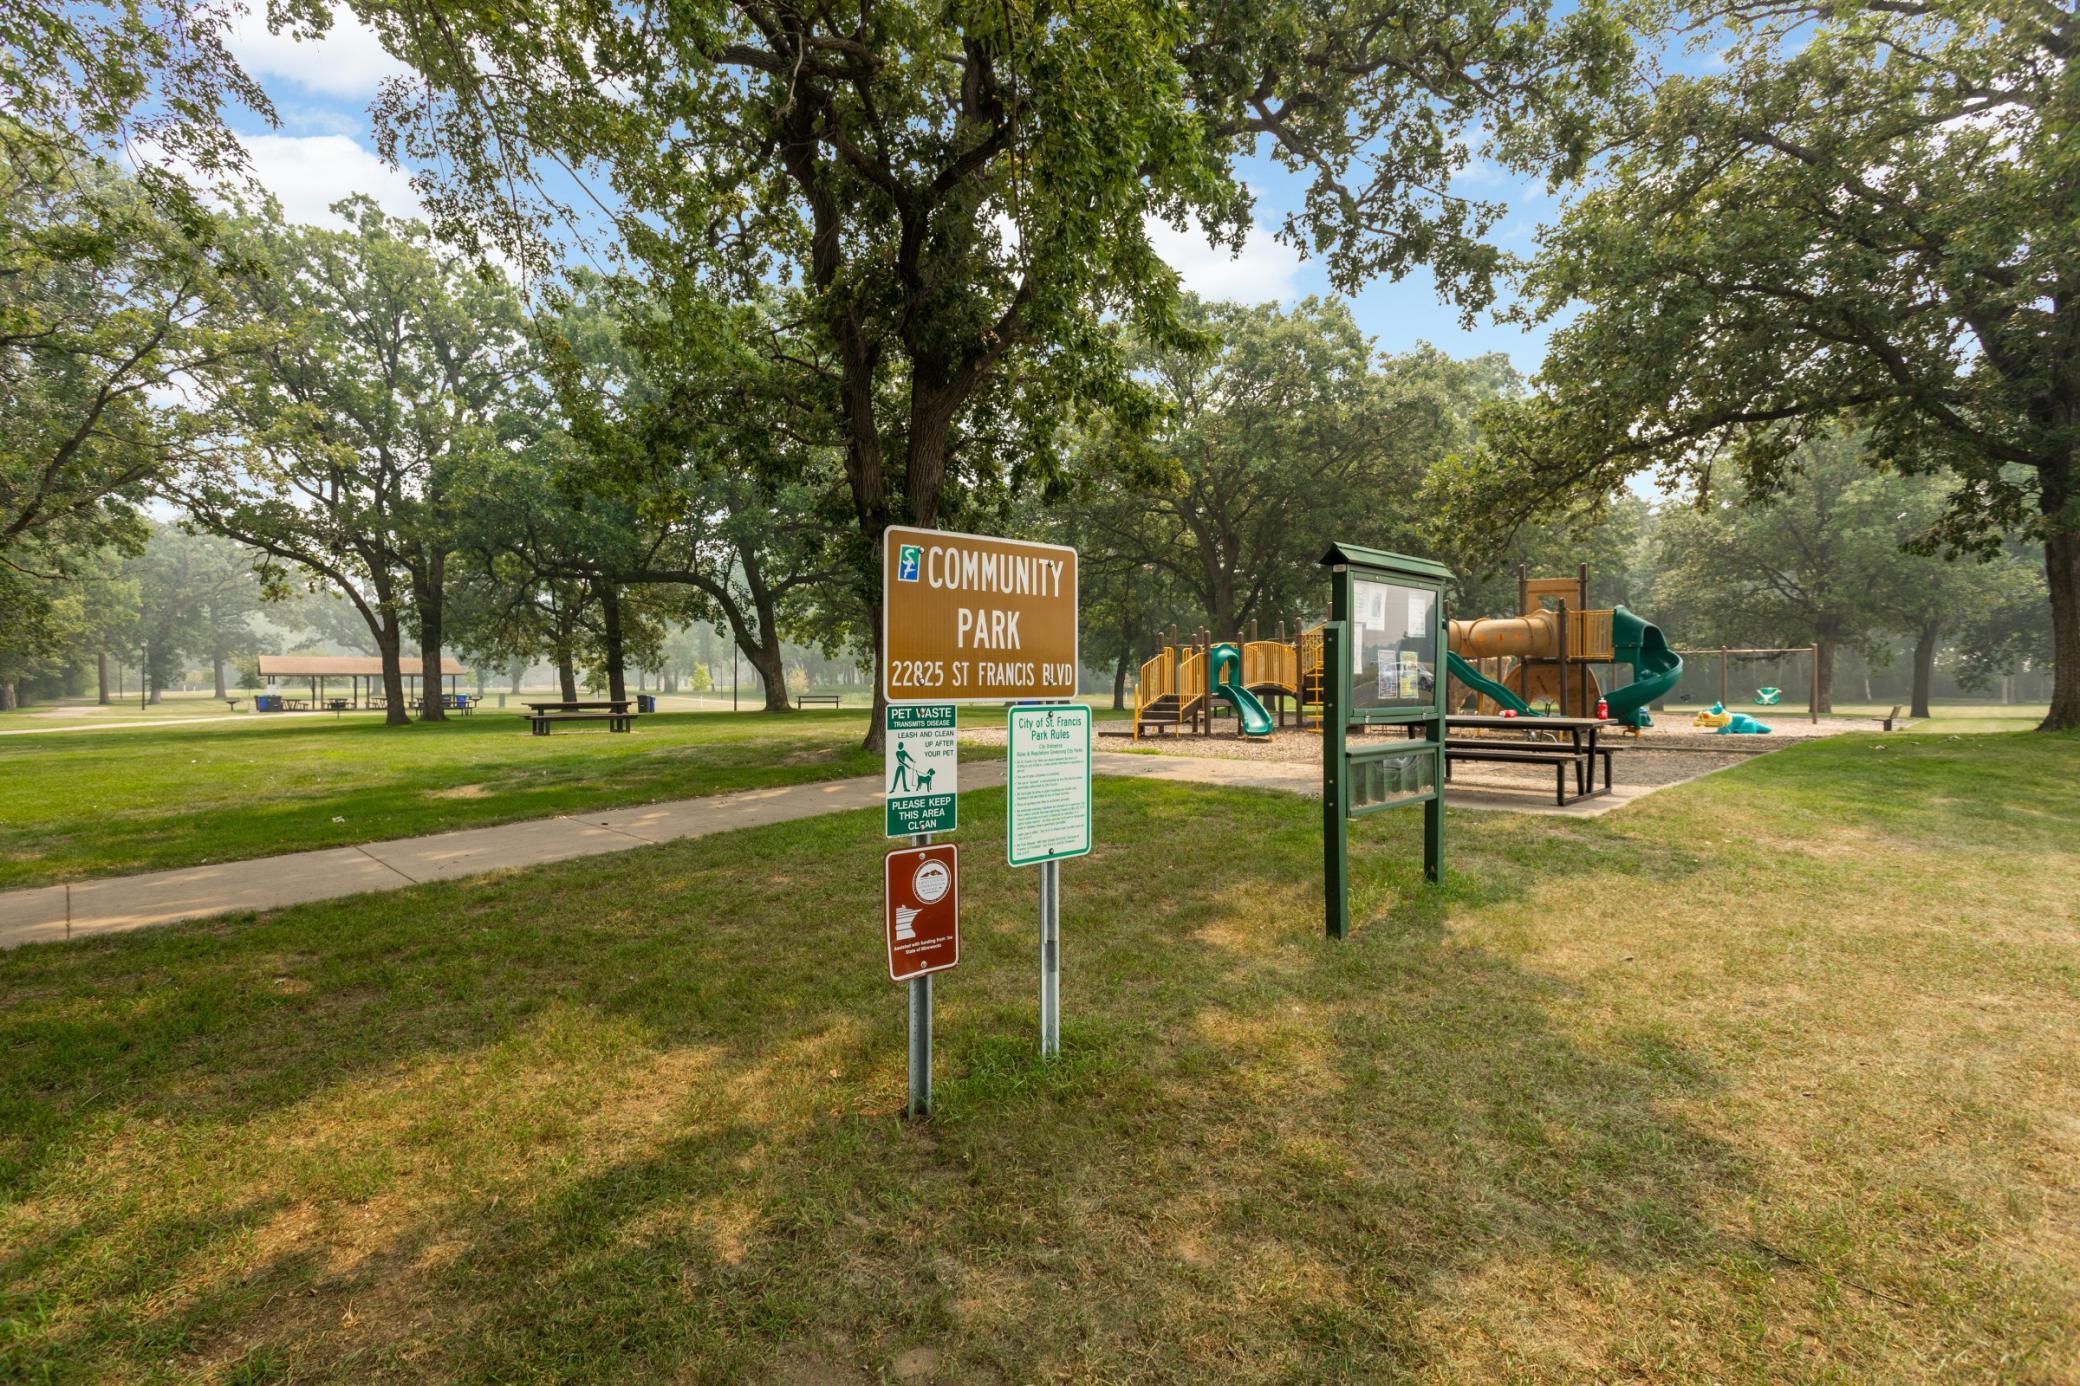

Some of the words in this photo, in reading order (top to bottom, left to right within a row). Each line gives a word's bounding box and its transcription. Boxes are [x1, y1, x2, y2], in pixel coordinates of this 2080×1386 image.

[928, 546, 1064, 597] COMMUNITY
[957, 608, 1021, 650] PARK
[892, 661, 944, 687] 22825
[952, 662, 970, 686] ST
[978, 662, 1035, 686] FRANCIS
[1043, 663, 1073, 686] BLVD
[891, 708, 912, 720] PET
[916, 707, 952, 718] WASTE
[893, 720, 925, 728] TRANSMITS
[927, 719, 950, 727] DISEASE
[1018, 718, 1033, 730] City
[1036, 717, 1043, 728] of
[1045, 717, 1055, 728] St.
[1057, 716, 1082, 727] Francis
[897, 731, 918, 739] LEASH
[1031, 730, 1048, 741] Park
[1050, 729, 1070, 740] Rules
[924, 750, 941, 758] YOUR
[892, 799, 926, 811] PLEASE
[928, 796, 952, 807] KEEP
[899, 810, 919, 821] THIS
[921, 808, 945, 818] AREA
[908, 819, 937, 831] CLEAN
